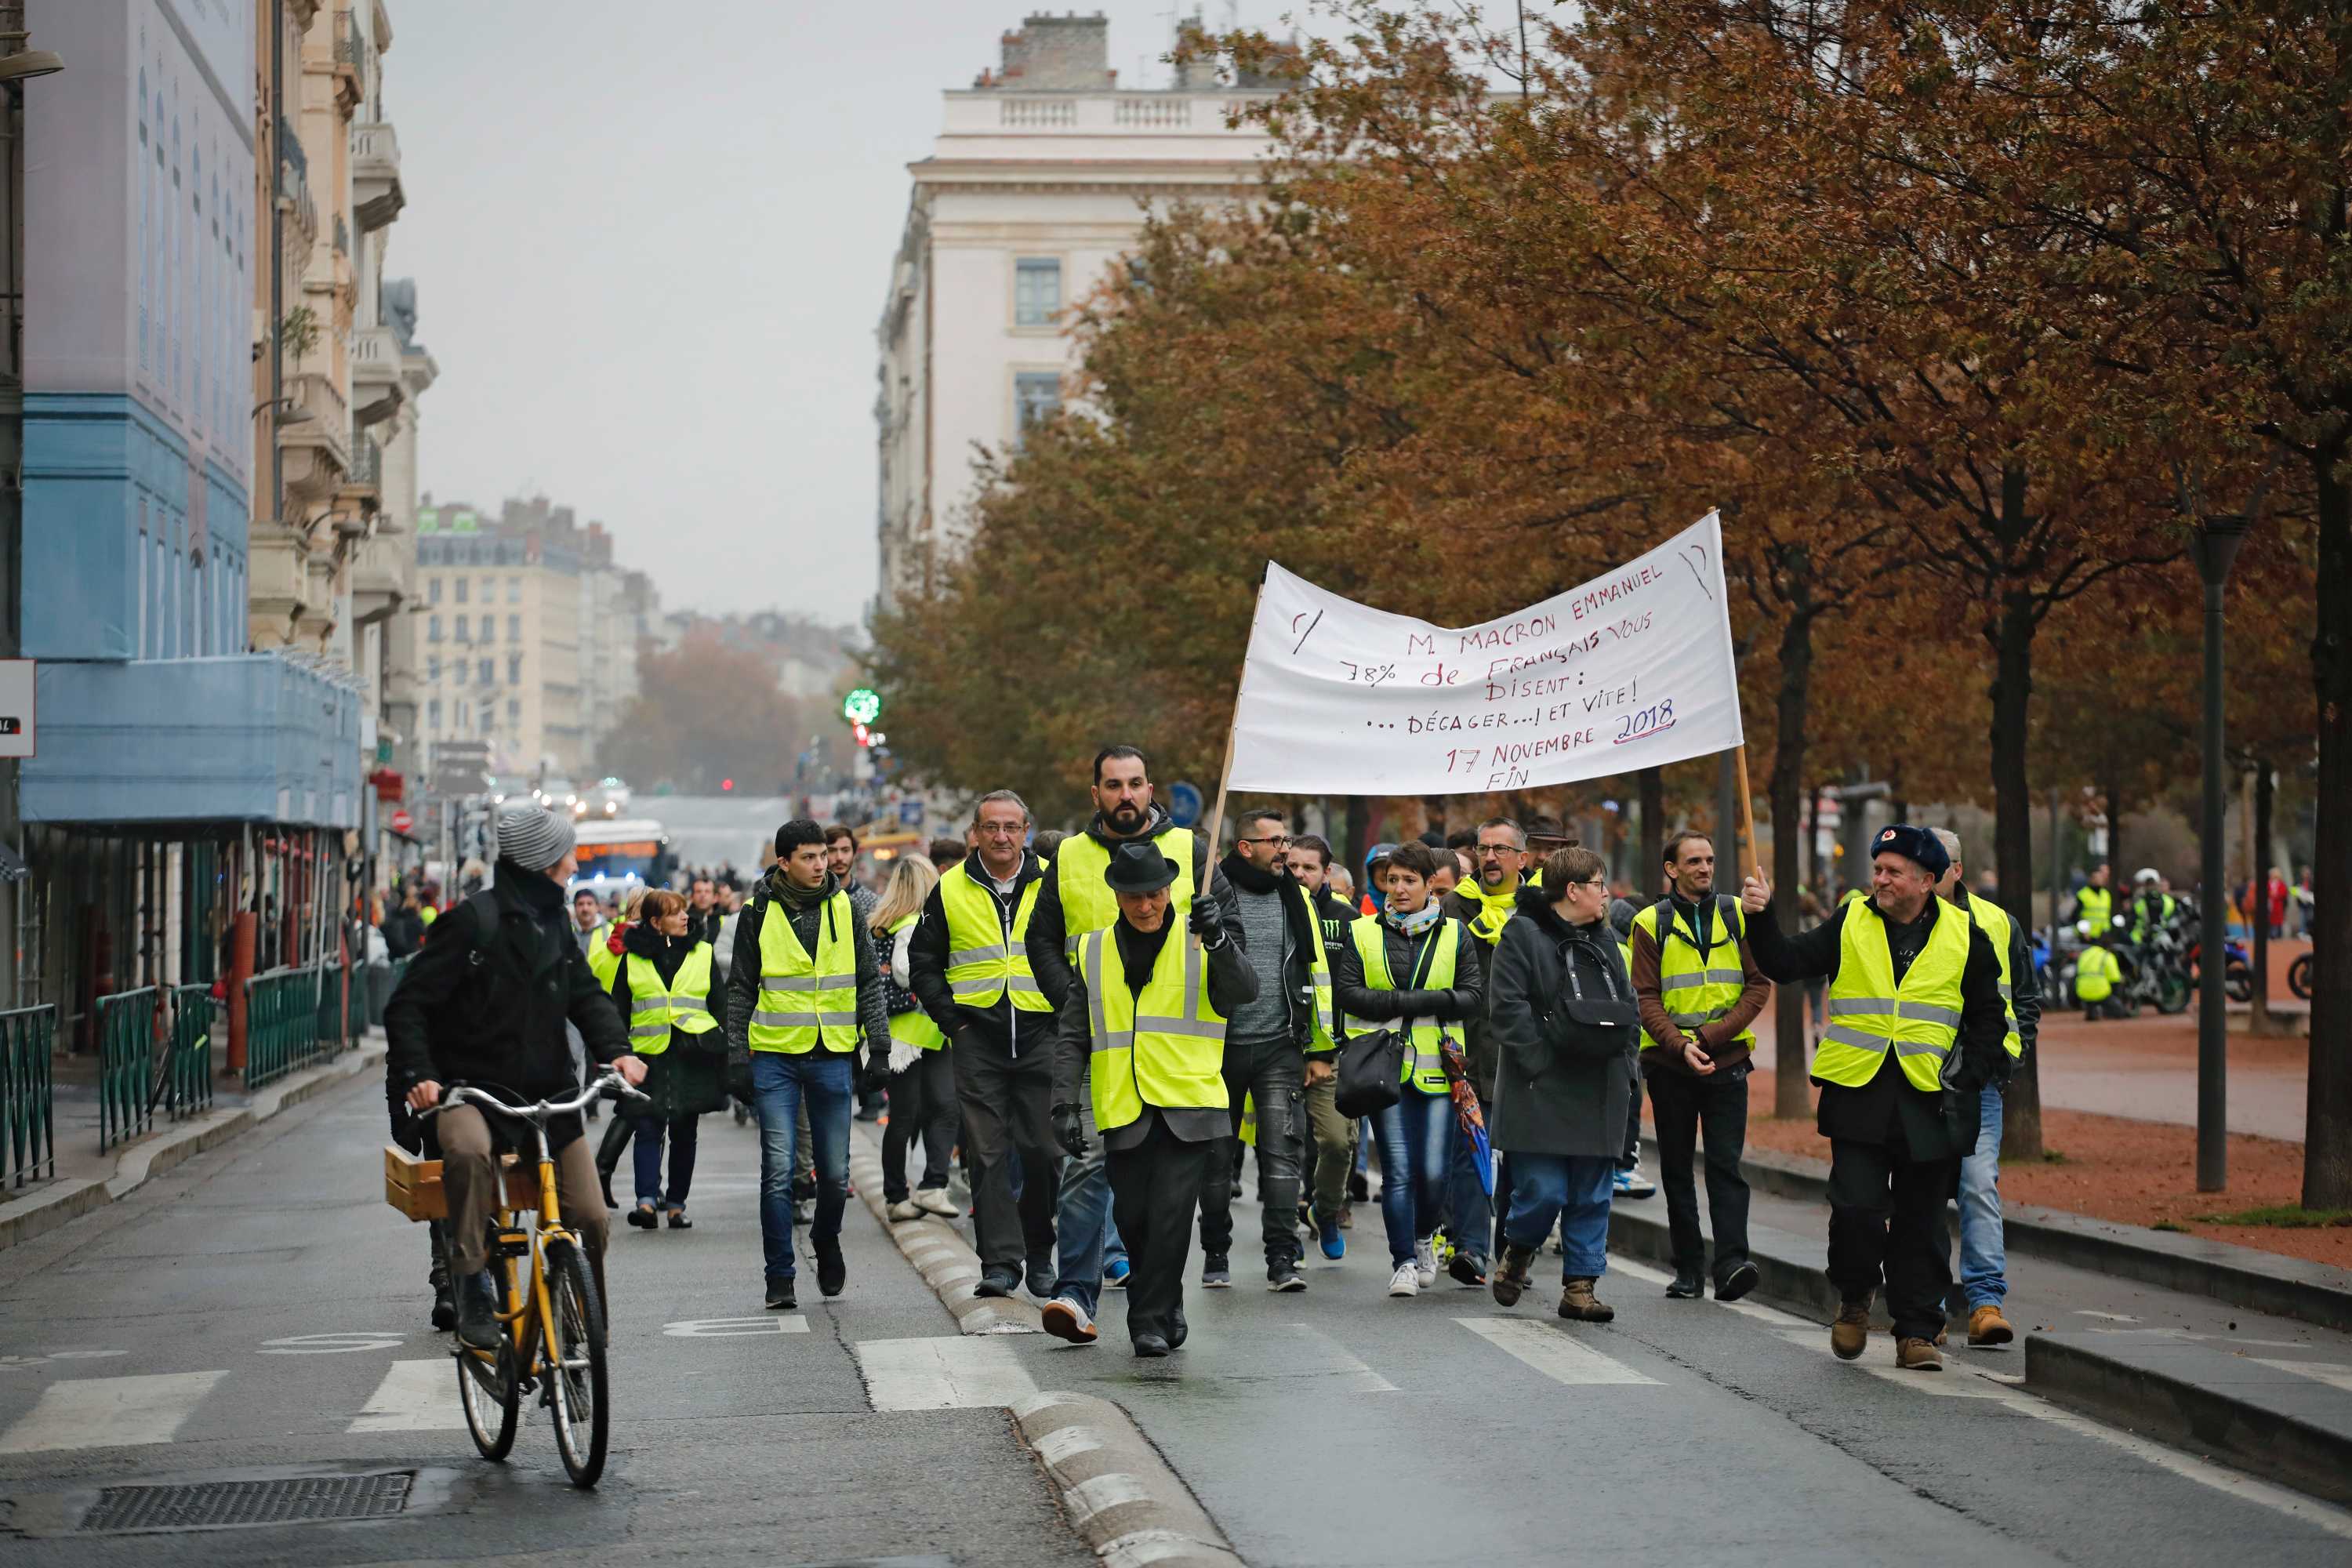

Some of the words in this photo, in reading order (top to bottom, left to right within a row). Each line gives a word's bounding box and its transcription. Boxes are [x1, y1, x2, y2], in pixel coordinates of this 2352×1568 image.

[1460, 615, 1555, 655] MACRON
[1571, 564, 1662, 619] EMMANUEL
[1421, 663, 1458, 686] de
[1606, 612, 1653, 640] VOUS
[1446, 749, 1481, 773] 17
[1492, 728, 1594, 767] NOVEMBRE
[1615, 699, 1673, 739] 2018
[1549, 702, 1571, 721] ET
